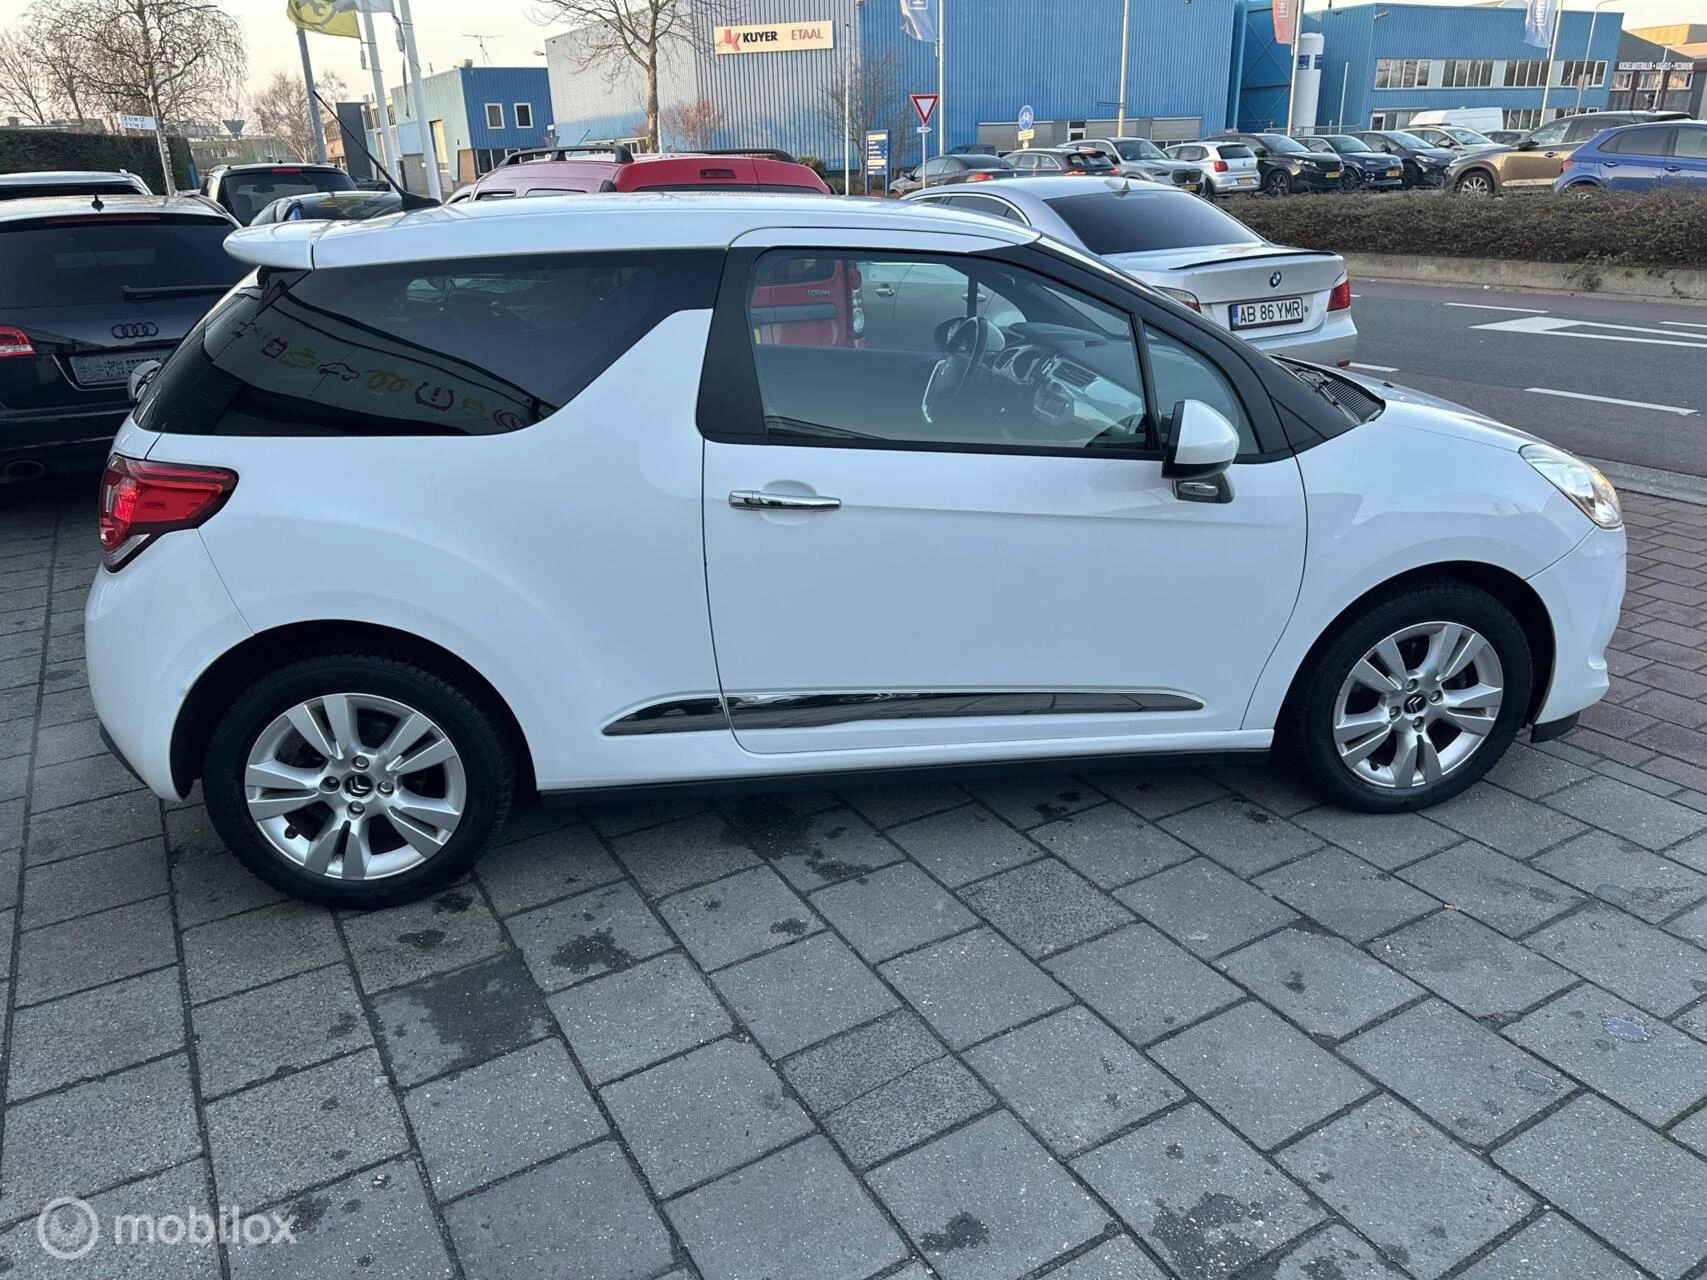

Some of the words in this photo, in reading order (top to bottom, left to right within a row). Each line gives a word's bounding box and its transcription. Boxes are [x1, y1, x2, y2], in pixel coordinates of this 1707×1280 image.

[743, 31, 778, 43] KUYER
[791, 28, 823, 40] ETAAL
[1240, 306, 1256, 323] AB
[1260, 304, 1275, 320] 86
[1276, 301, 1300, 319] YMR
